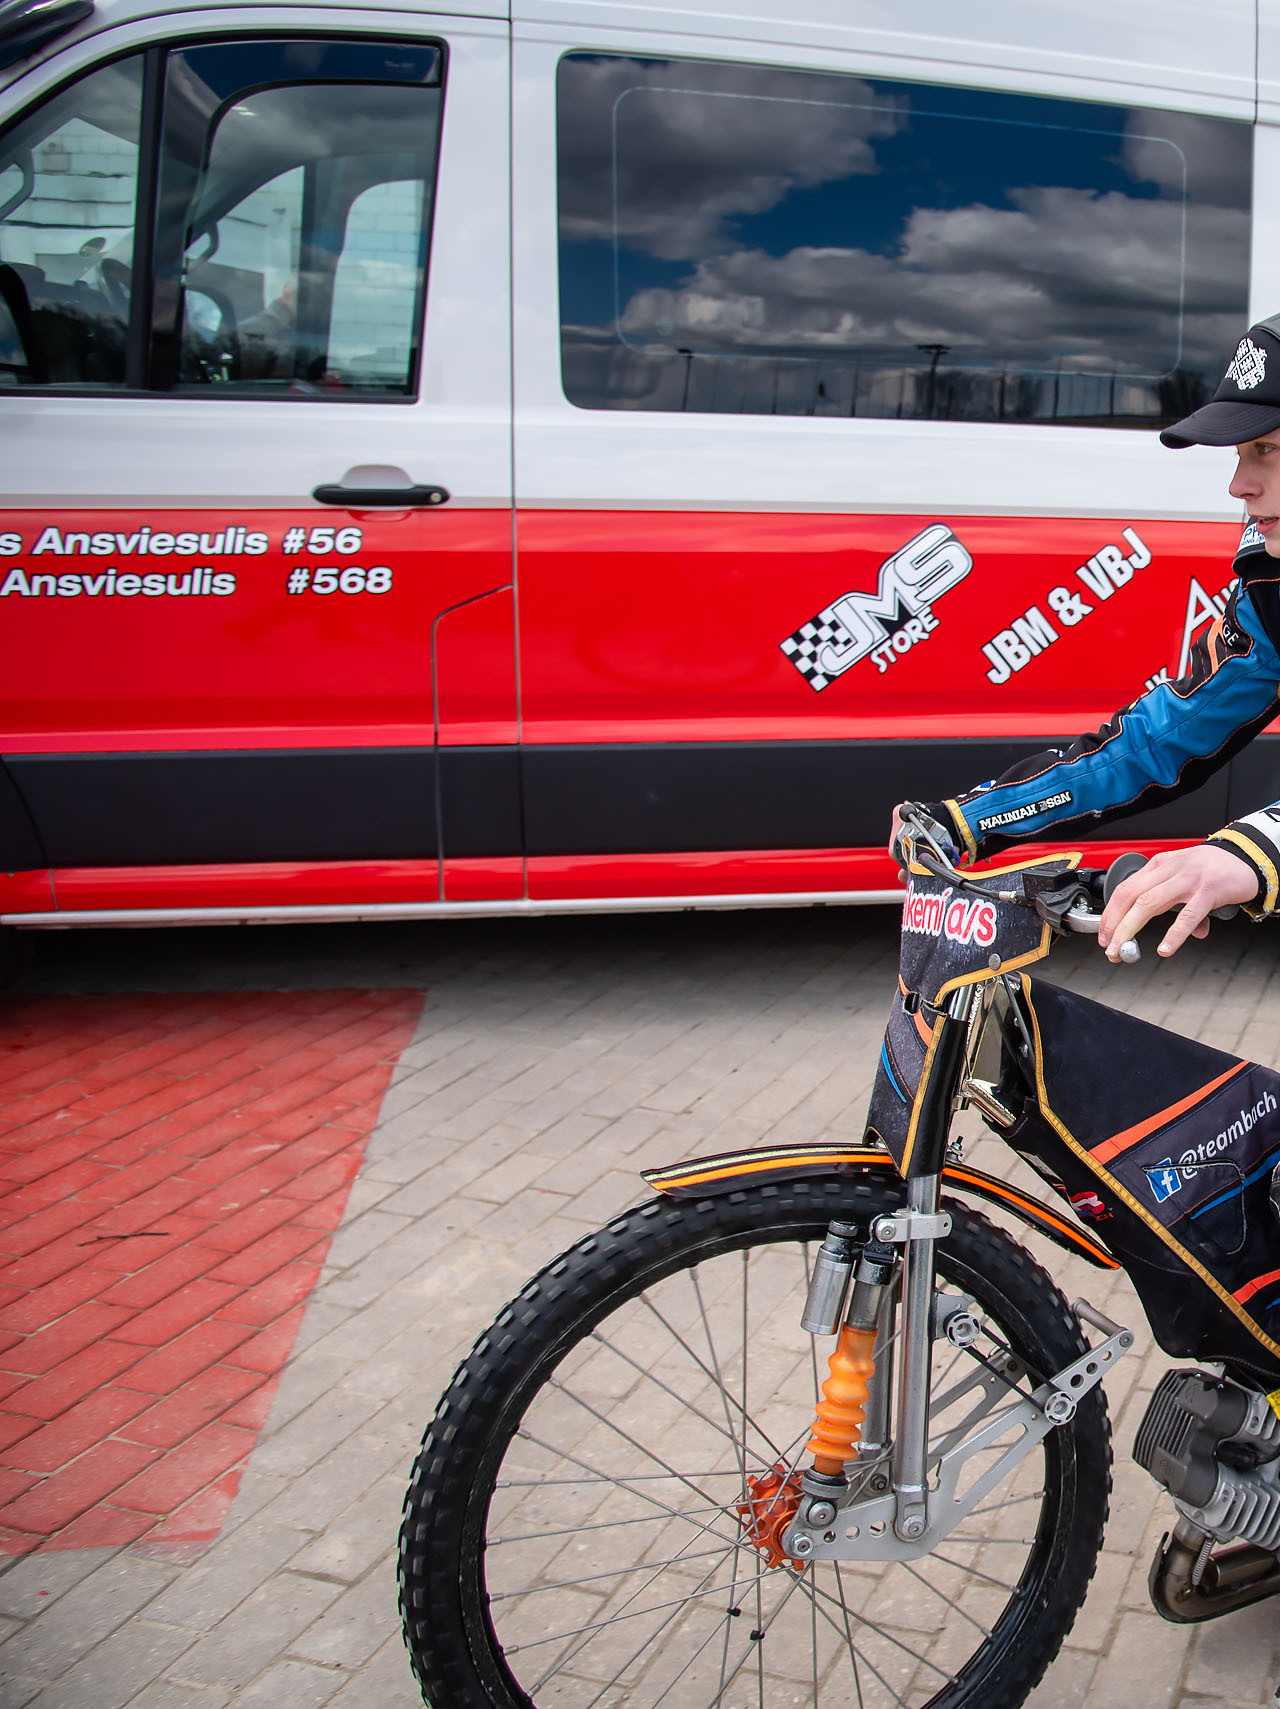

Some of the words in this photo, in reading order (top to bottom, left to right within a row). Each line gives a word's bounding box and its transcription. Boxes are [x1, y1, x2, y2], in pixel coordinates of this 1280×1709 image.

[31, 526, 269, 556] Ansviesulis
[282, 527, 364, 555] #56
[0, 567, 237, 597] Ansviesulis
[287, 566, 393, 595] #568
[818, 523, 974, 678] JMS
[980, 604, 1060, 685] JBM
[1047, 586, 1096, 626] &
[1074, 525, 1152, 601] VBJ
[870, 606, 940, 675] STORE
[979, 803, 1037, 831] MALINIAK
[944, 898, 997, 947] a/s
[1178, 1091, 1278, 1180] @teambach
